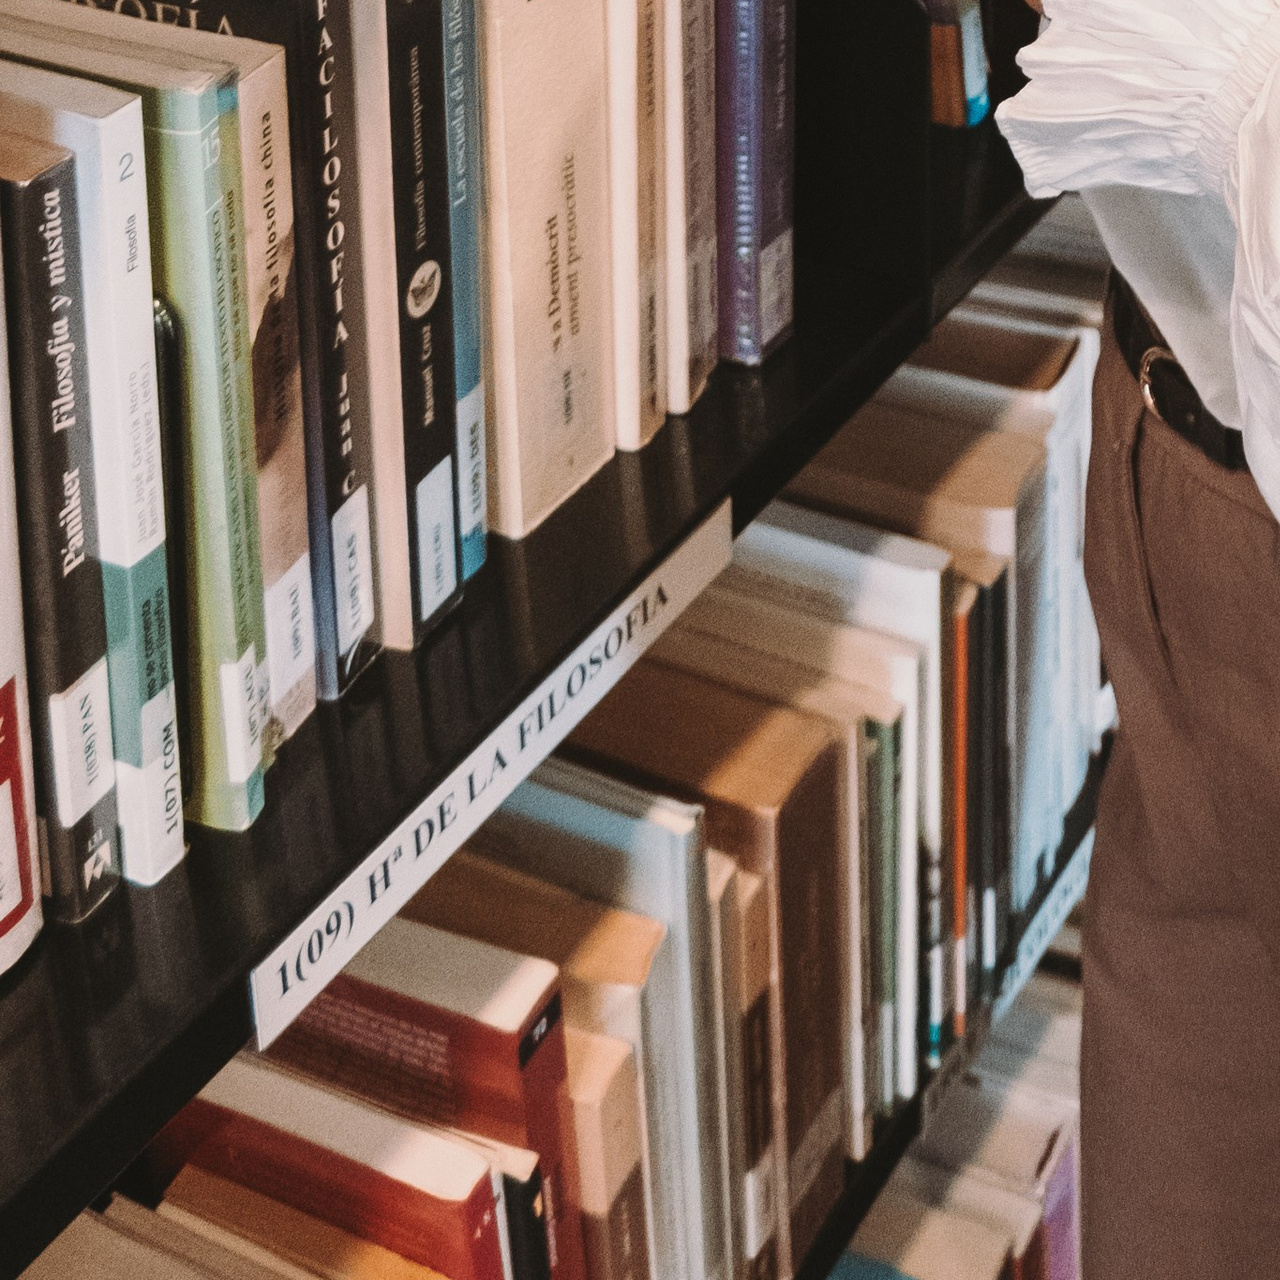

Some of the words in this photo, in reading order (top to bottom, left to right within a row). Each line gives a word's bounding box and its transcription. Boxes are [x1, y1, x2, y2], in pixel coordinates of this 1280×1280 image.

[450, 40, 464, 75] los
[450, 78, 465, 100] de
[275, 899, 355, 998] 1(09)
[411, 791, 459, 863] DE
[464, 746, 509, 806] LA
[515, 581, 671, 754] FILOSOFIA
